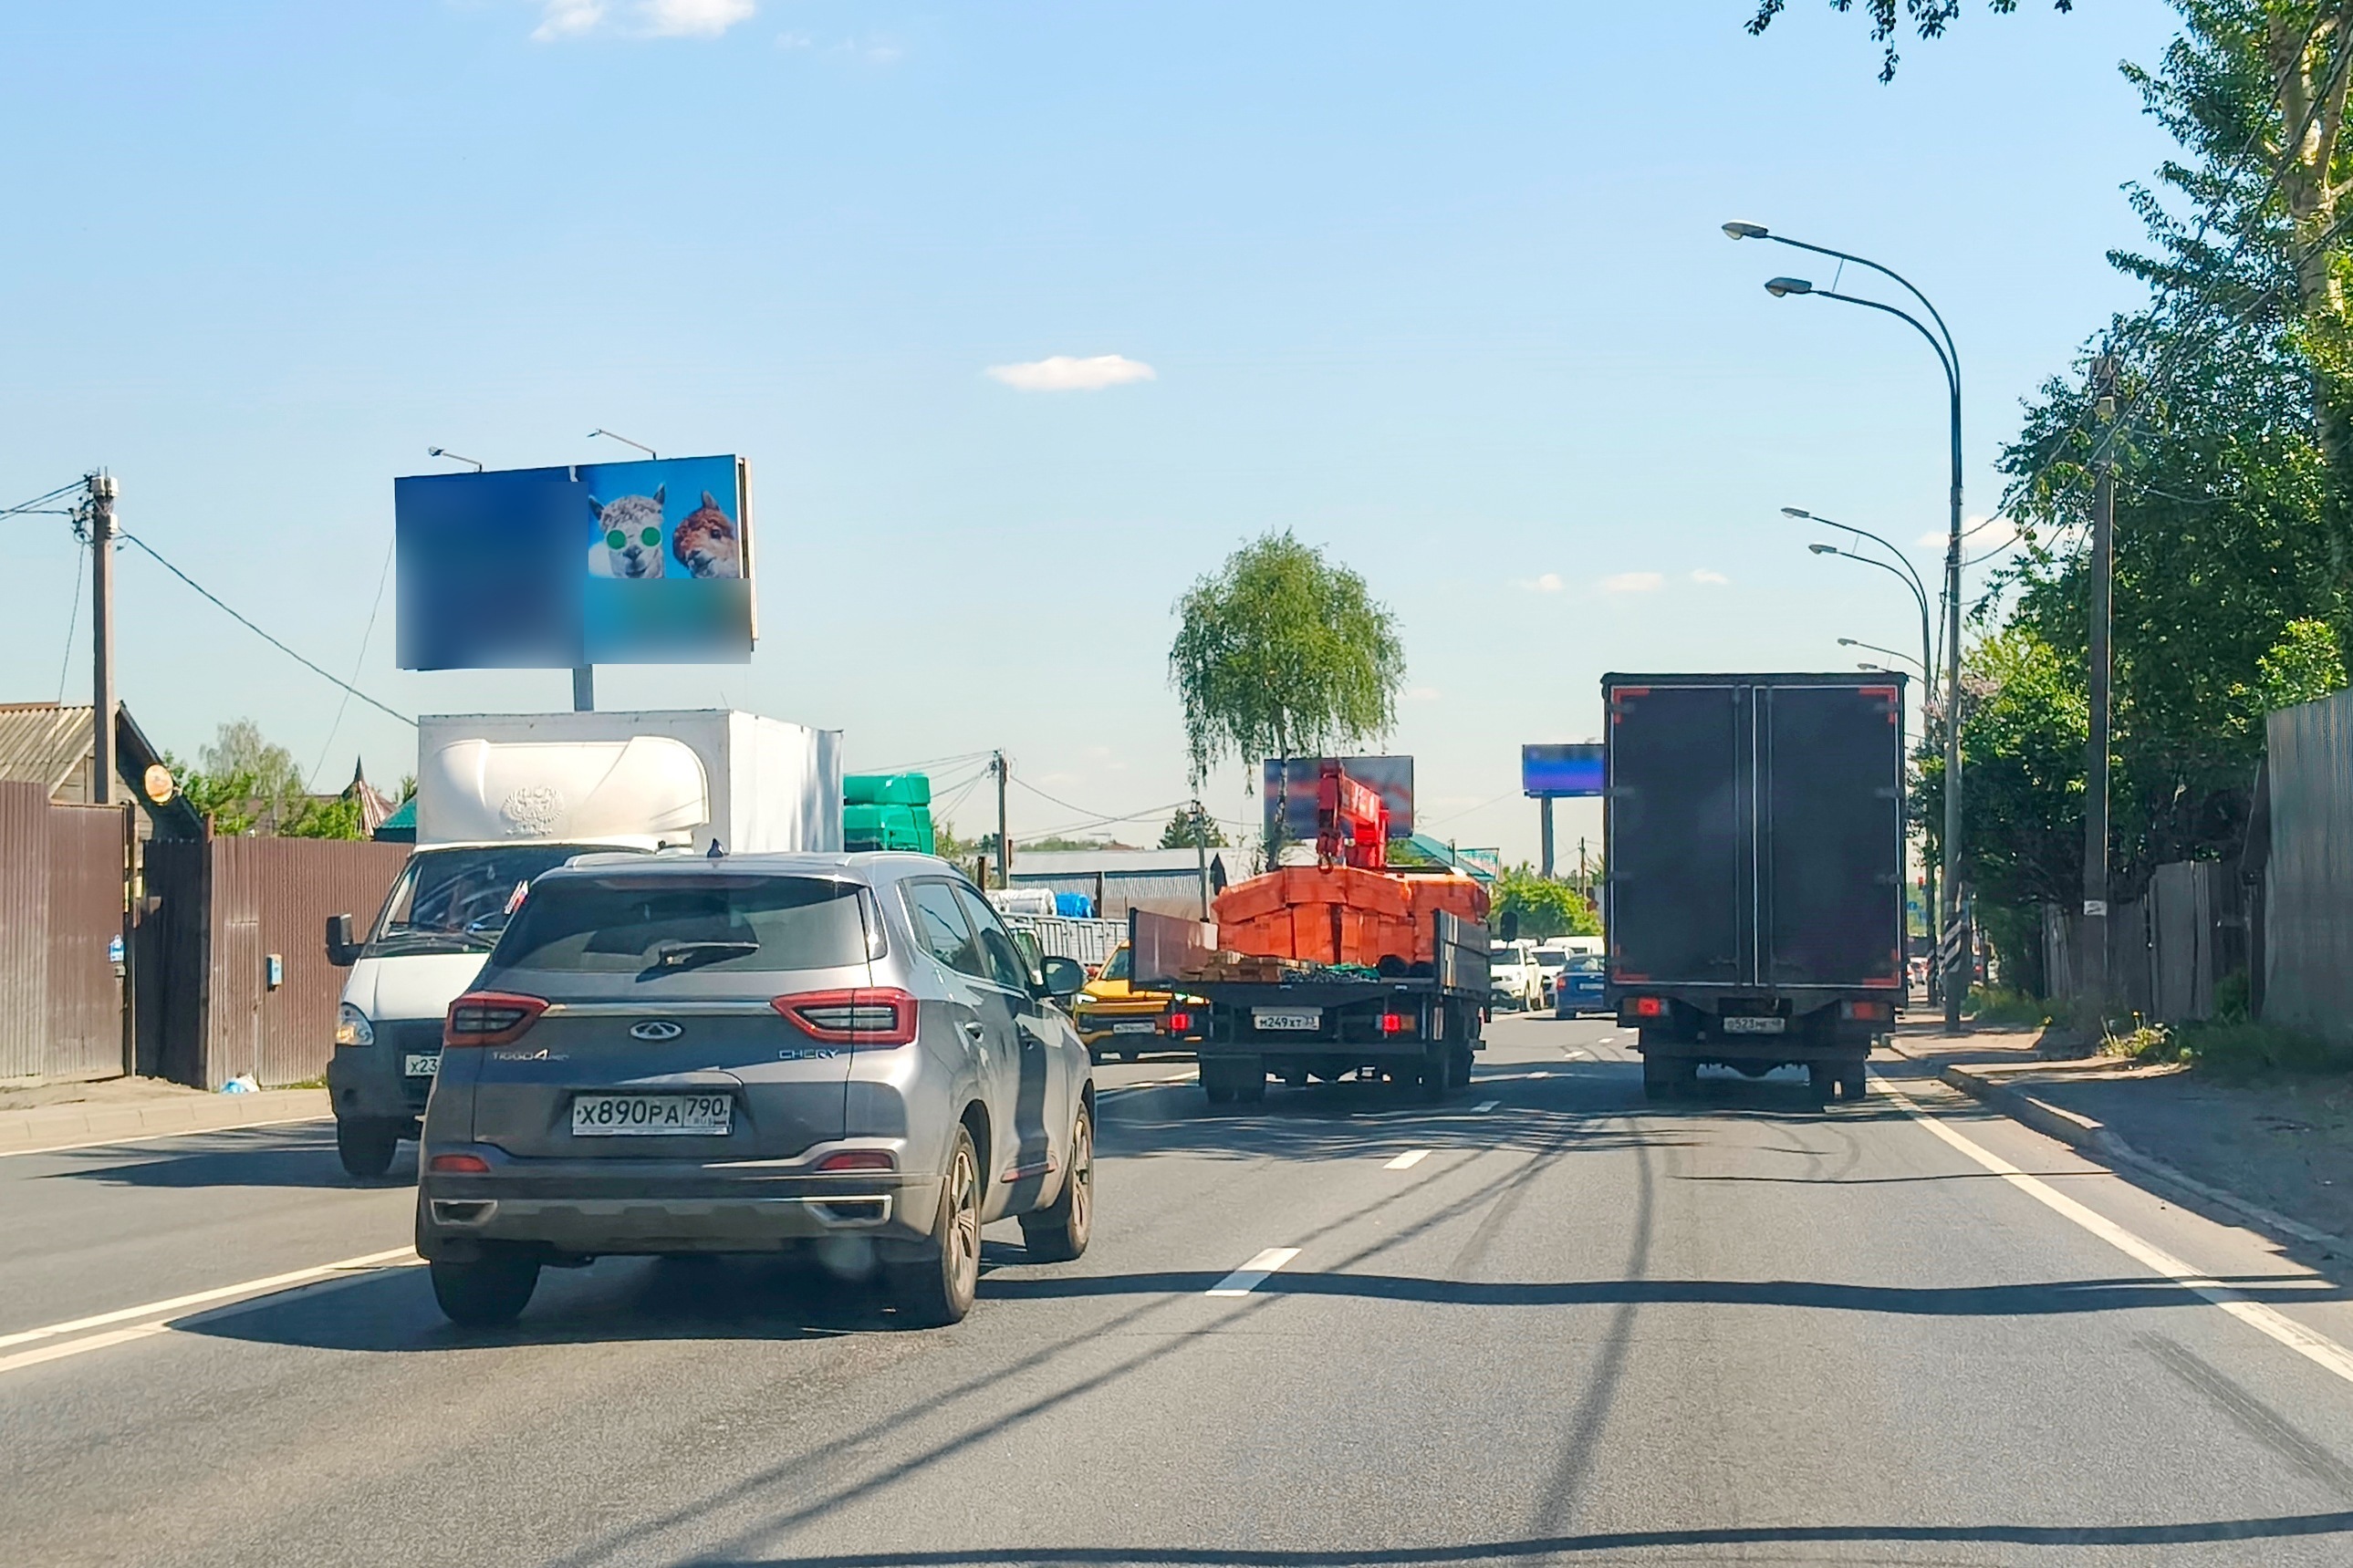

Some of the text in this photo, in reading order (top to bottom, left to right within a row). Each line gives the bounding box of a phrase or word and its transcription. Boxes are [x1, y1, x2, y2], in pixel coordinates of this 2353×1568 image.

[778, 1048, 838, 1059] CHERY
[580, 1097, 724, 1125] Х890РА 790
